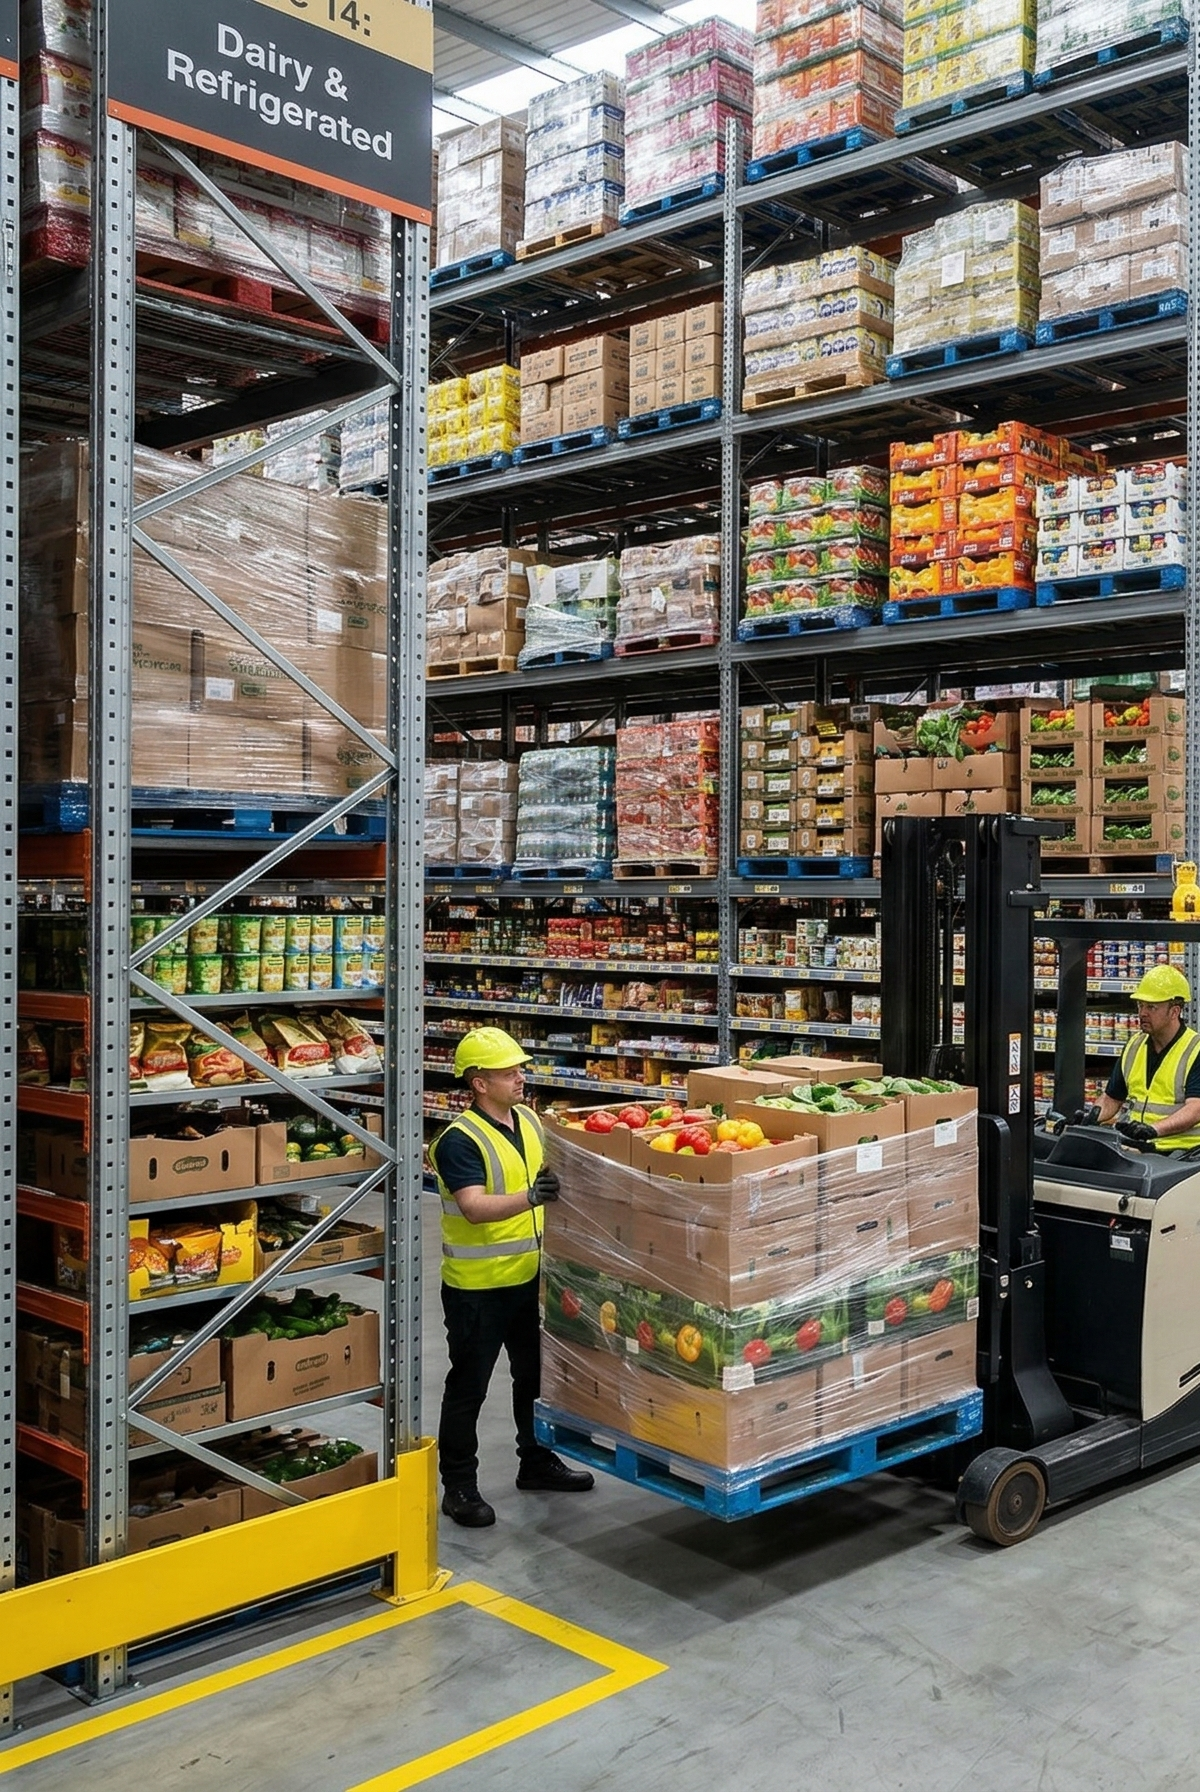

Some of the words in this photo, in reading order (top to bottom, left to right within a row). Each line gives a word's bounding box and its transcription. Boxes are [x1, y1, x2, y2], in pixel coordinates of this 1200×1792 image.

[167, 48, 393, 161] Refrigerated
[217, 23, 313, 92] Dairy
[324, 67, 349, 102] &
